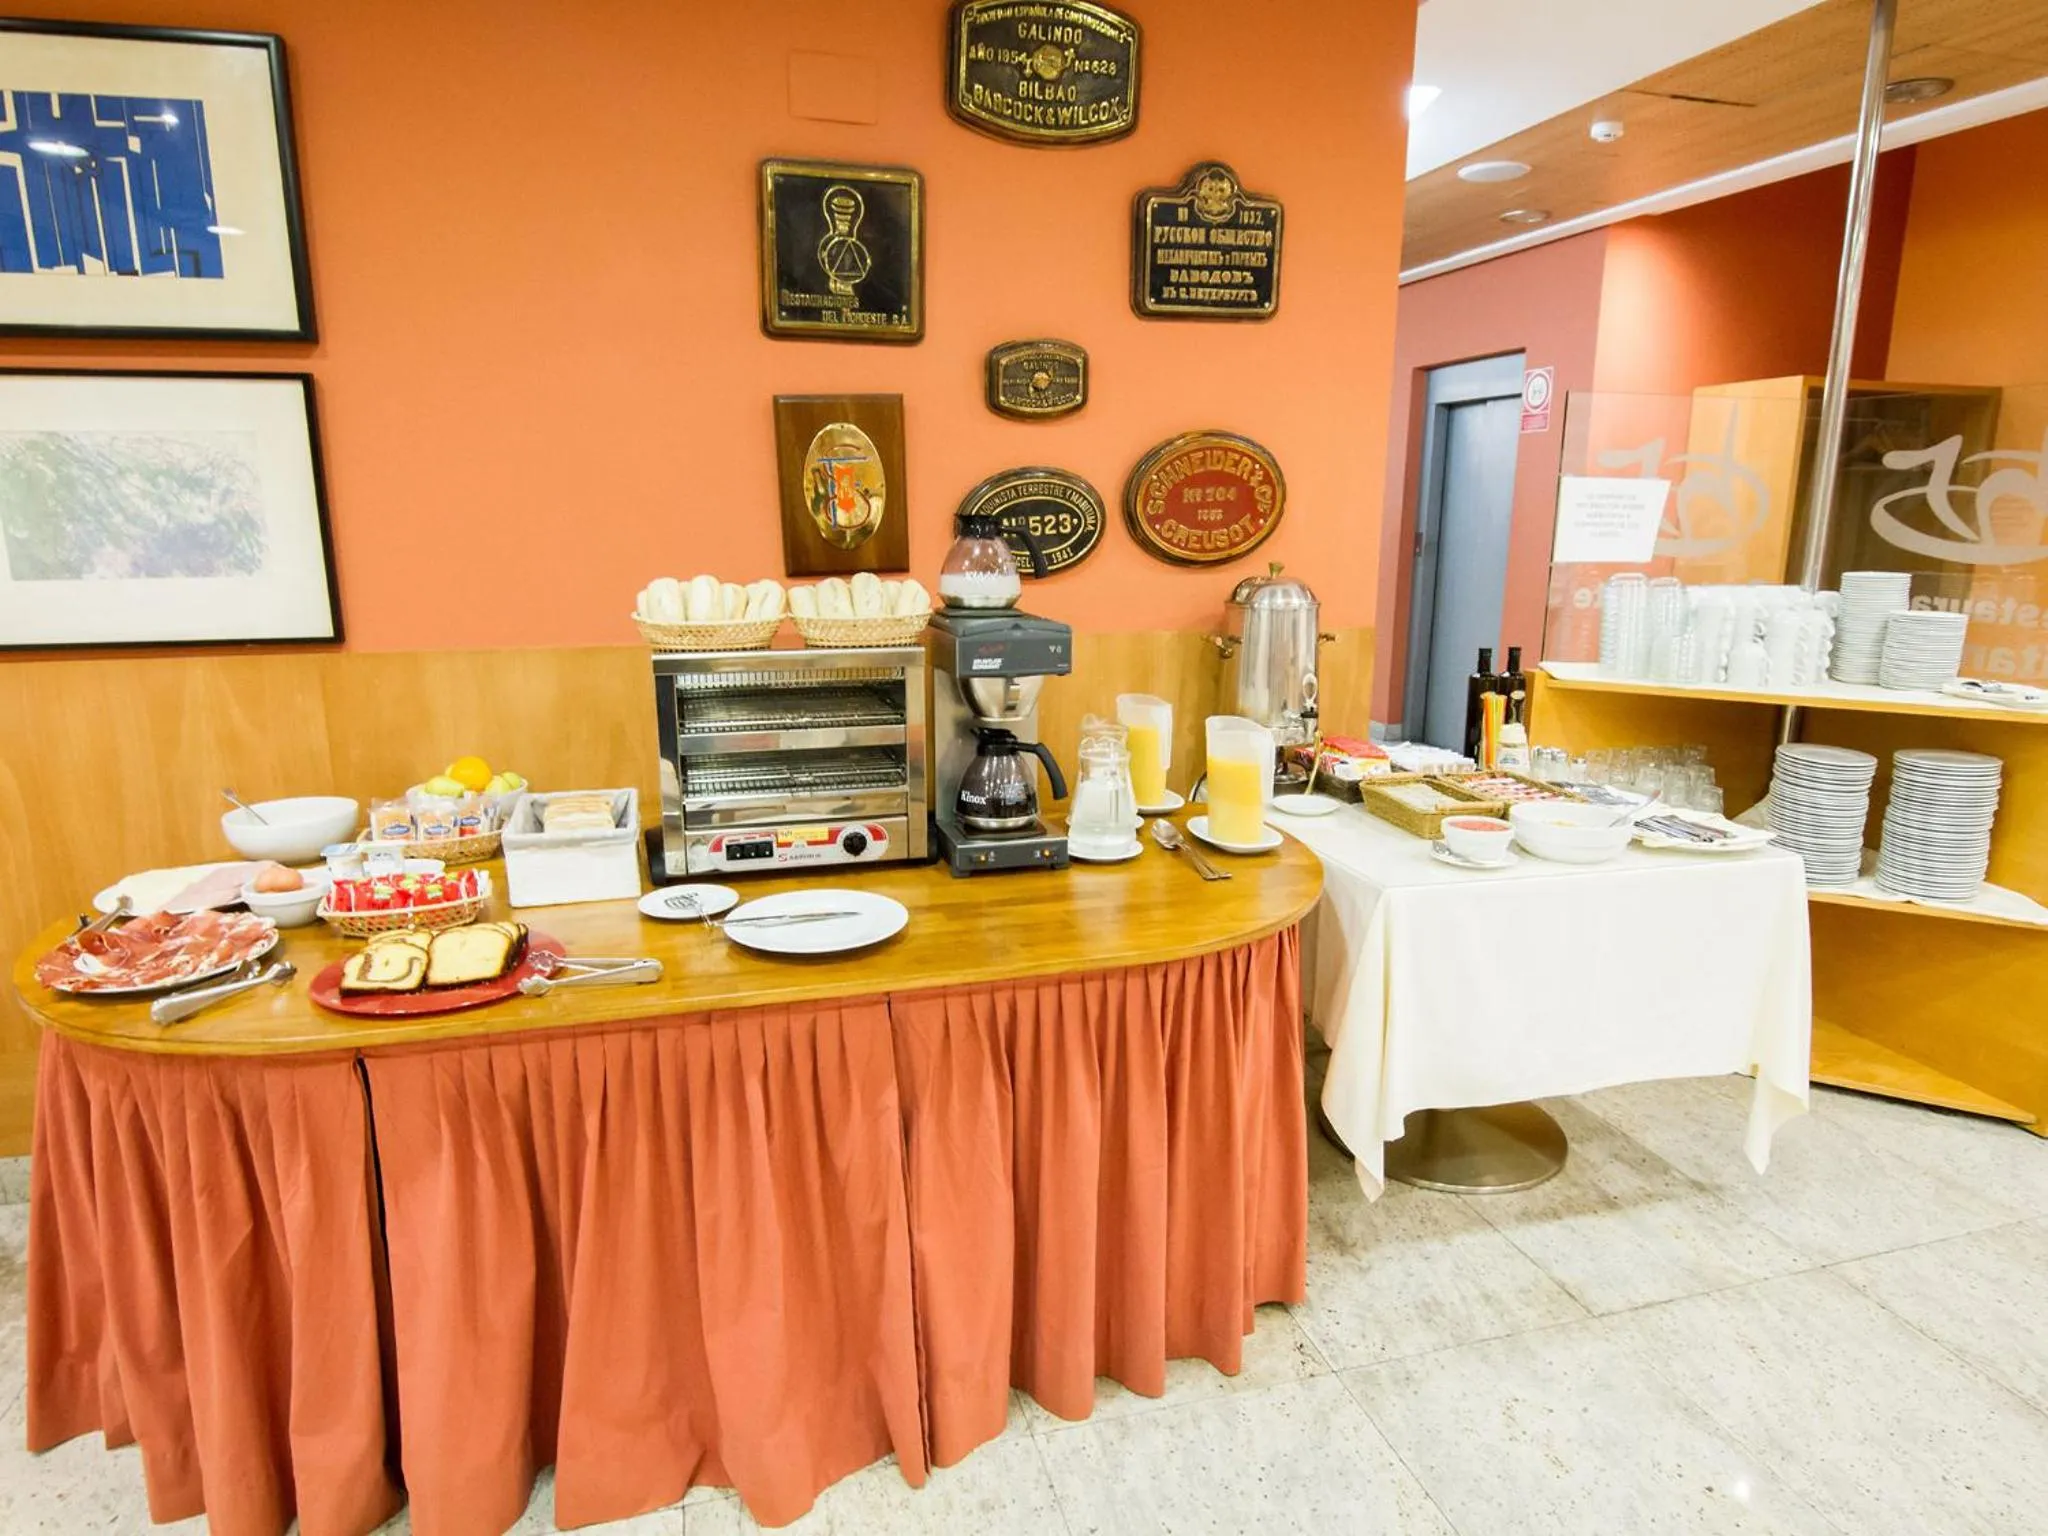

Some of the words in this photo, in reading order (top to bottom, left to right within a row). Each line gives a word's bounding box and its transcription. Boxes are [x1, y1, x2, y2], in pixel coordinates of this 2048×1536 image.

[1018, 22, 1083, 44] GALINDO
[968, 42, 994, 62] AÑO
[1019, 80, 1077, 101] BILBAO
[822, 310, 839, 324] DEL
[1017, 483, 1065, 498] TERRESTRE
[1146, 449, 1252, 515] SCHNEIDER
[1028, 513, 1072, 537] 523
[1160, 513, 1256, 550] CREUSOT
[1052, 547, 1073, 564] 1941
[960, 789, 986, 805] Kinox
